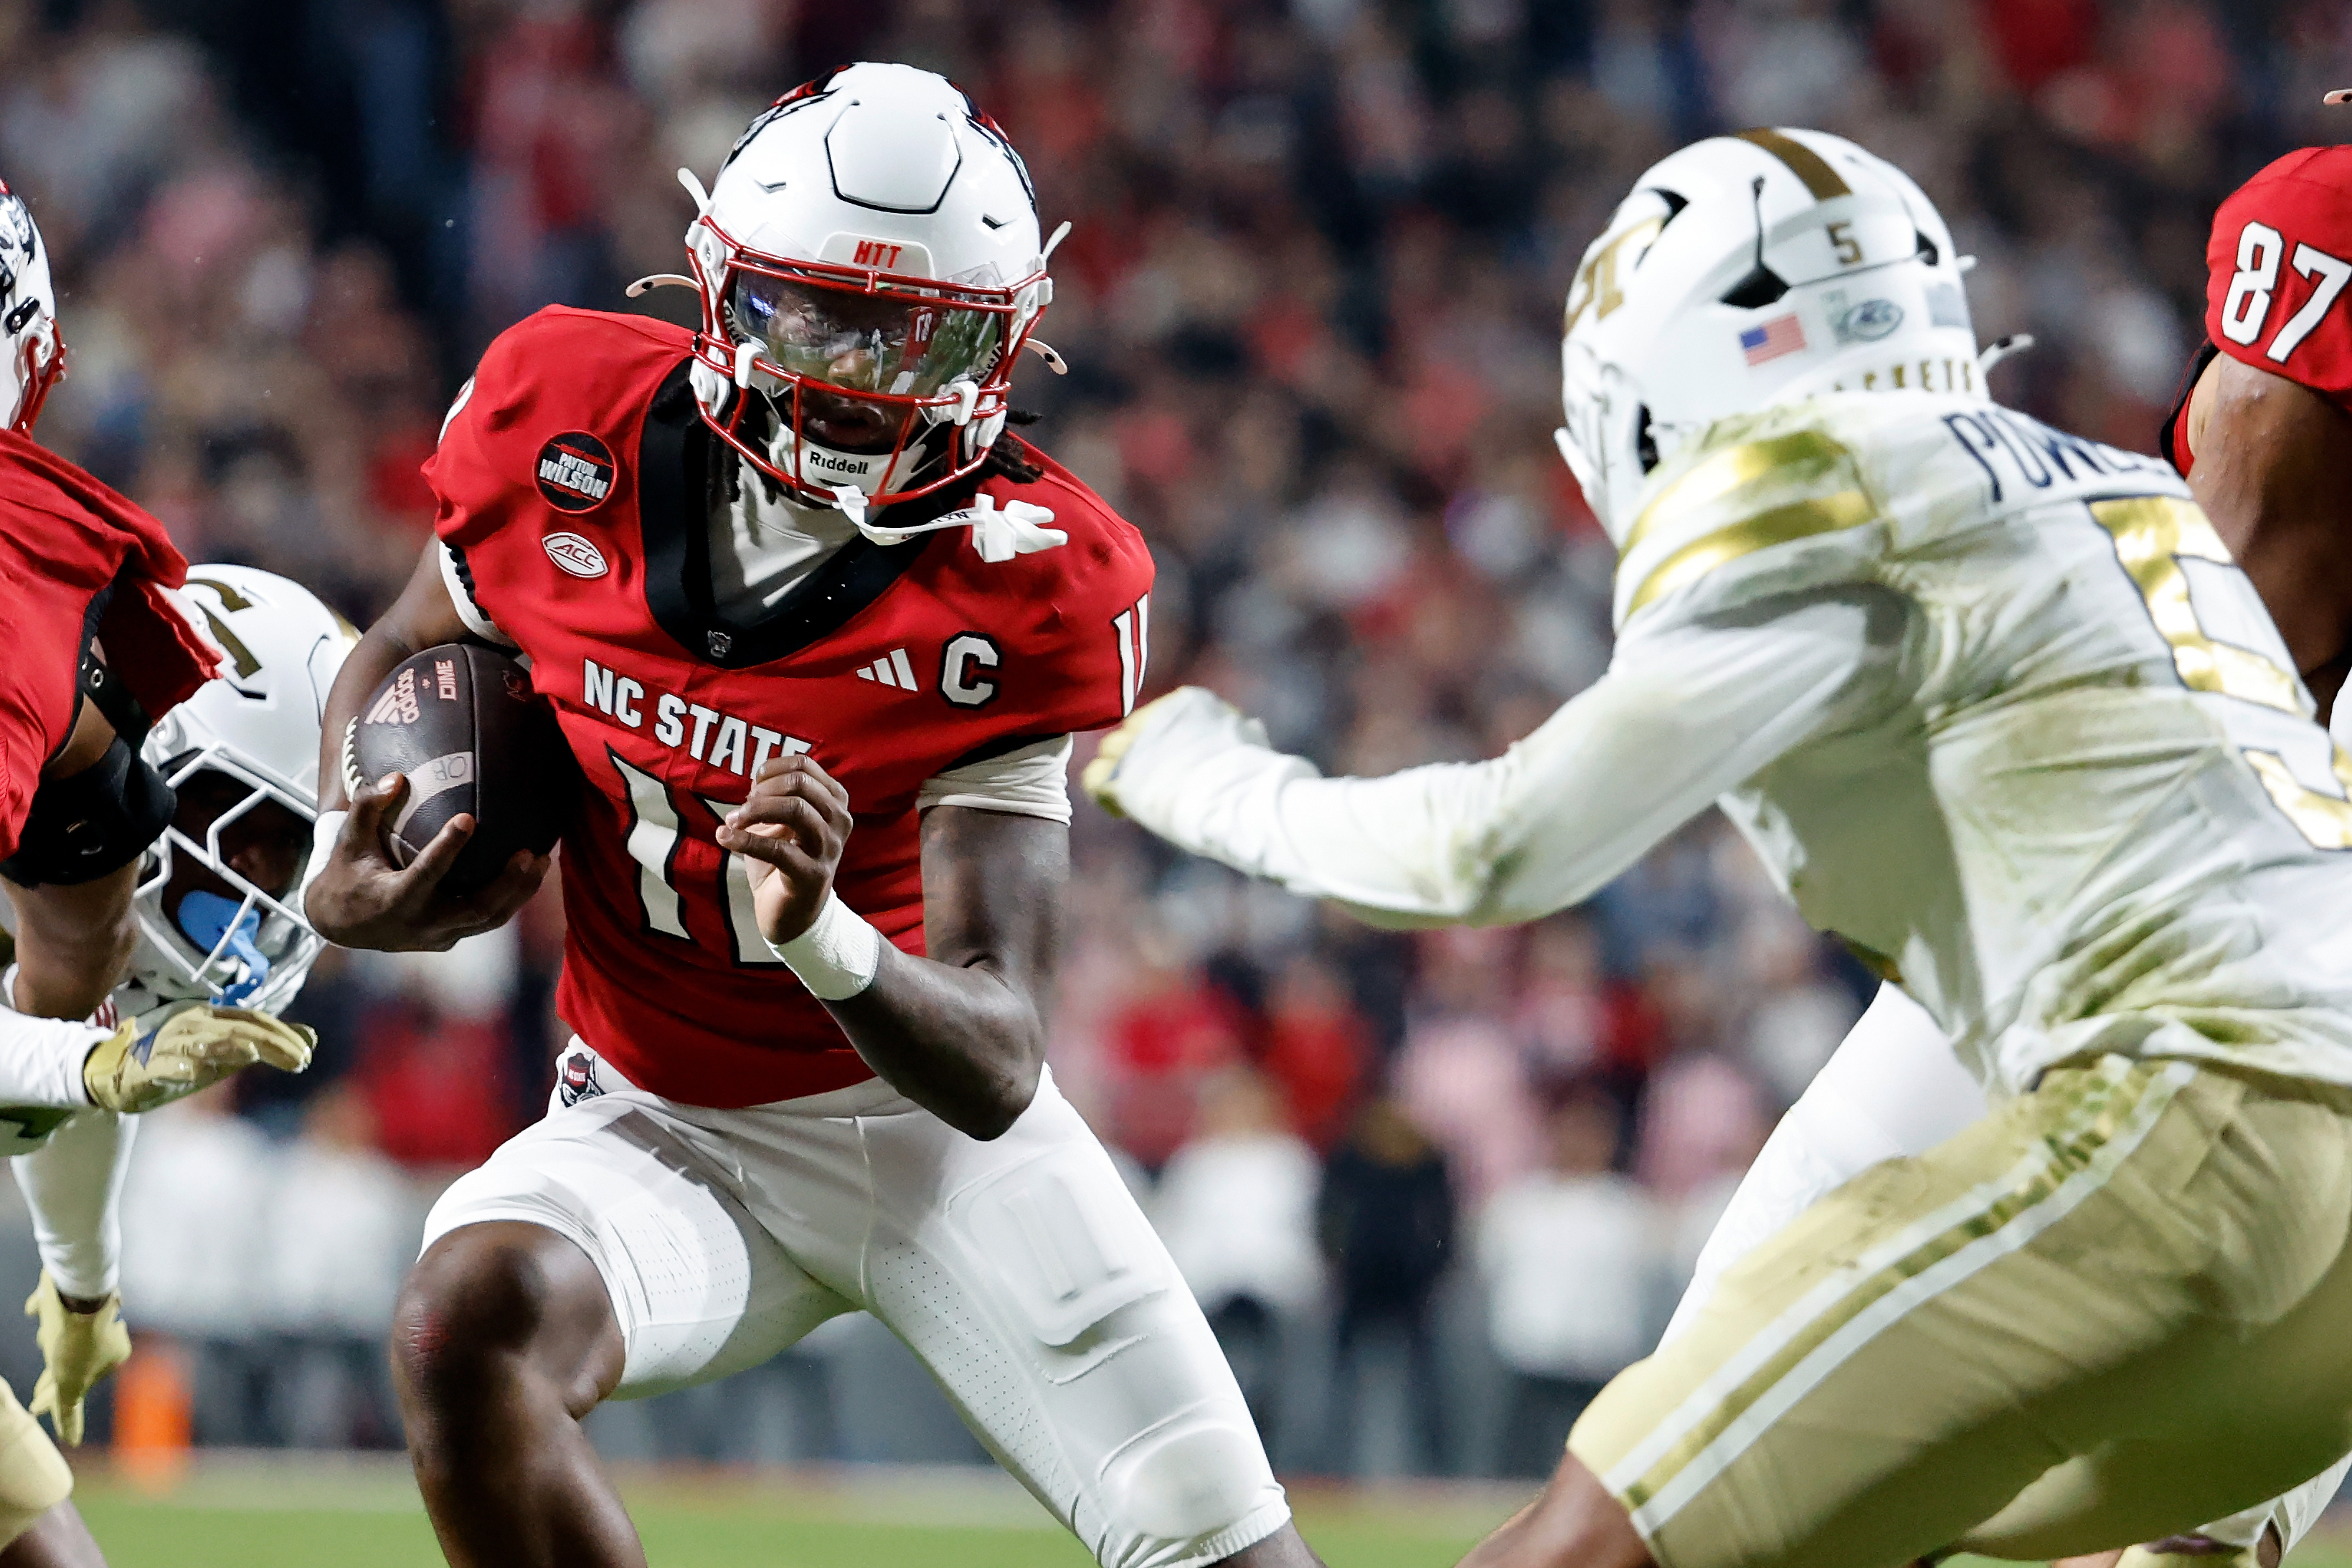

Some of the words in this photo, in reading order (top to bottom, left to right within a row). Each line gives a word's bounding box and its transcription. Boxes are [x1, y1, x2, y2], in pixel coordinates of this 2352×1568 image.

[854, 240, 902, 269] HTT
[1826, 220, 1864, 265] 5
[2221, 220, 2352, 366] 87
[539, 458, 609, 499] WILSON
[810, 449, 869, 475] Riddell
[553, 543, 600, 567] ACC
[435, 658, 458, 701] DIME
[941, 634, 999, 707] C
[395, 667, 421, 725] adidas
[583, 658, 644, 728] NC
